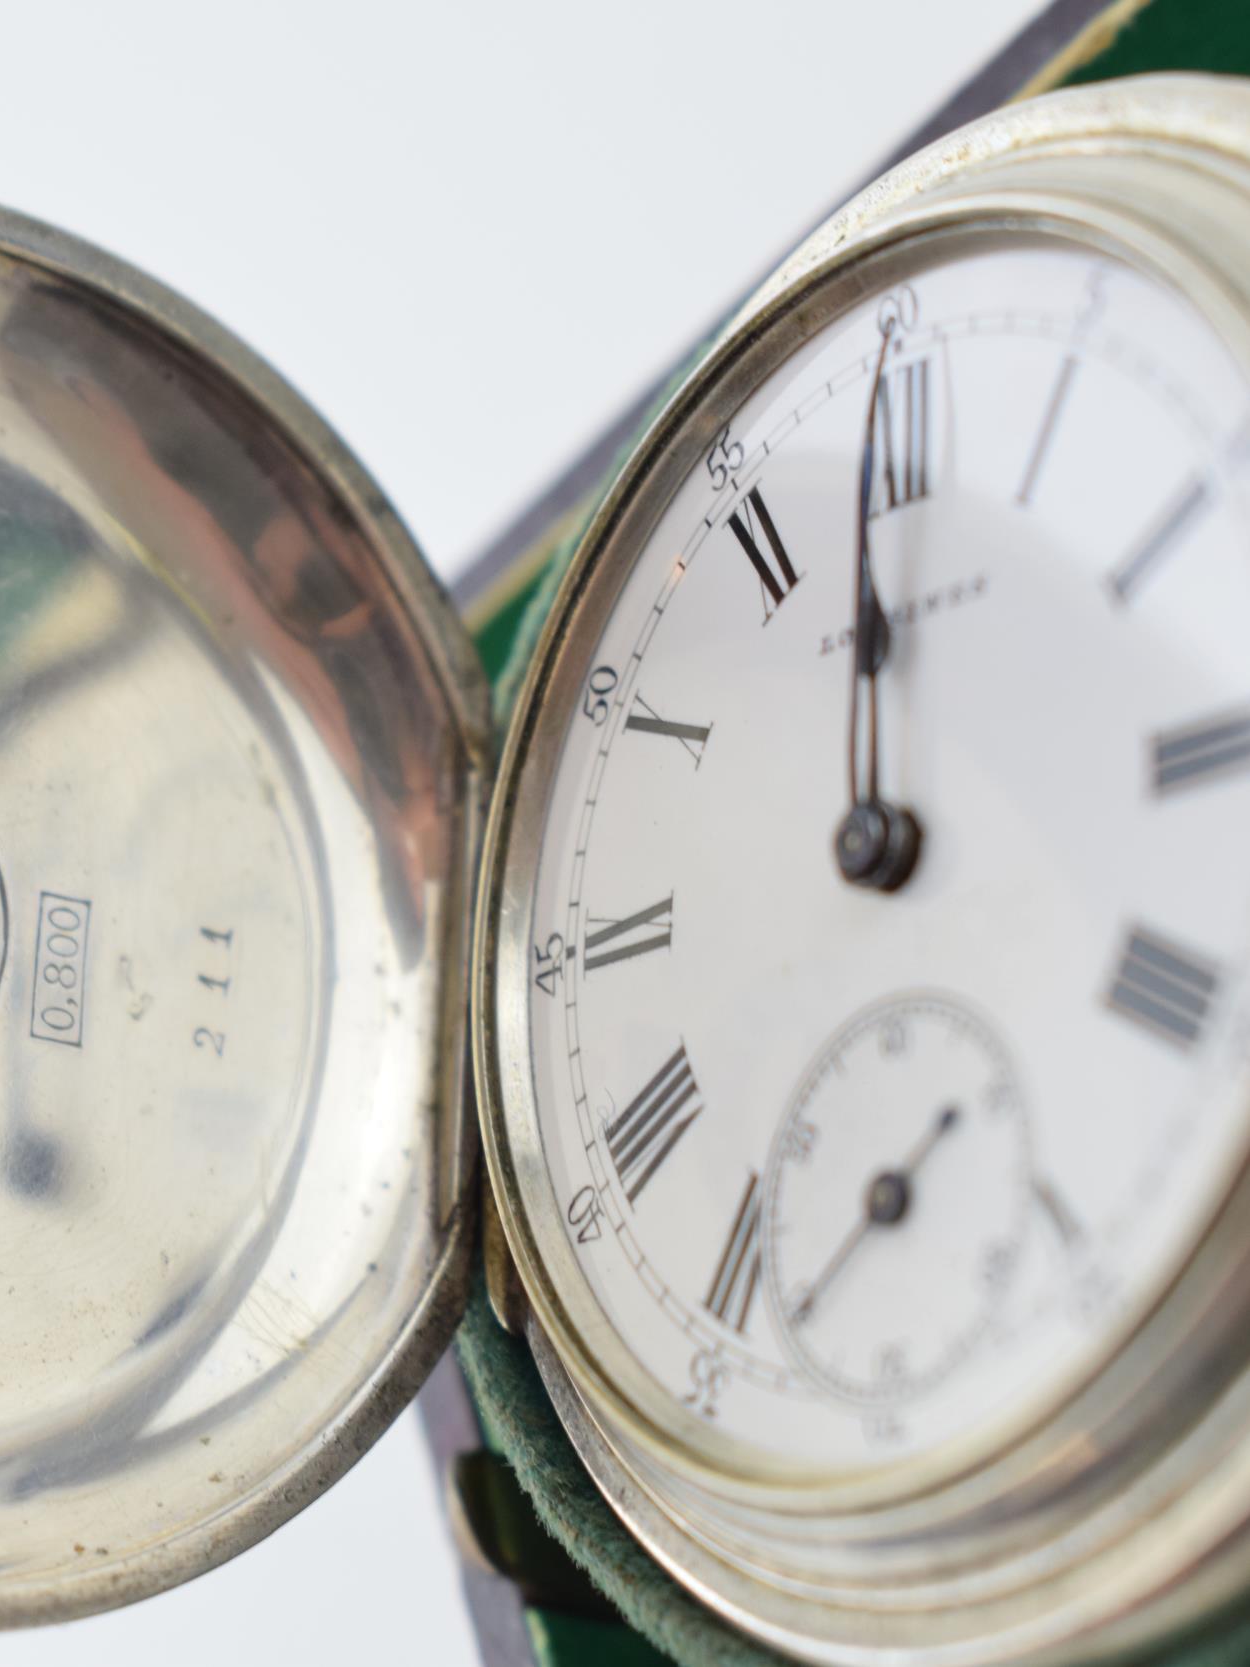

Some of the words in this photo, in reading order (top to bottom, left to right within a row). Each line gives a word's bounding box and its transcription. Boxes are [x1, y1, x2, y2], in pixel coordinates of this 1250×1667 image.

[706, 423, 745, 492] 55
[723, 478, 807, 628] XI
[584, 665, 618, 728] 50
[622, 688, 714, 772] X
[40, 906, 81, 1032] 0,800
[535, 932, 565, 998] 45
[582, 889, 674, 981] IX
[605, 1034, 706, 1214] VIII
[567, 1185, 605, 1244] 40
